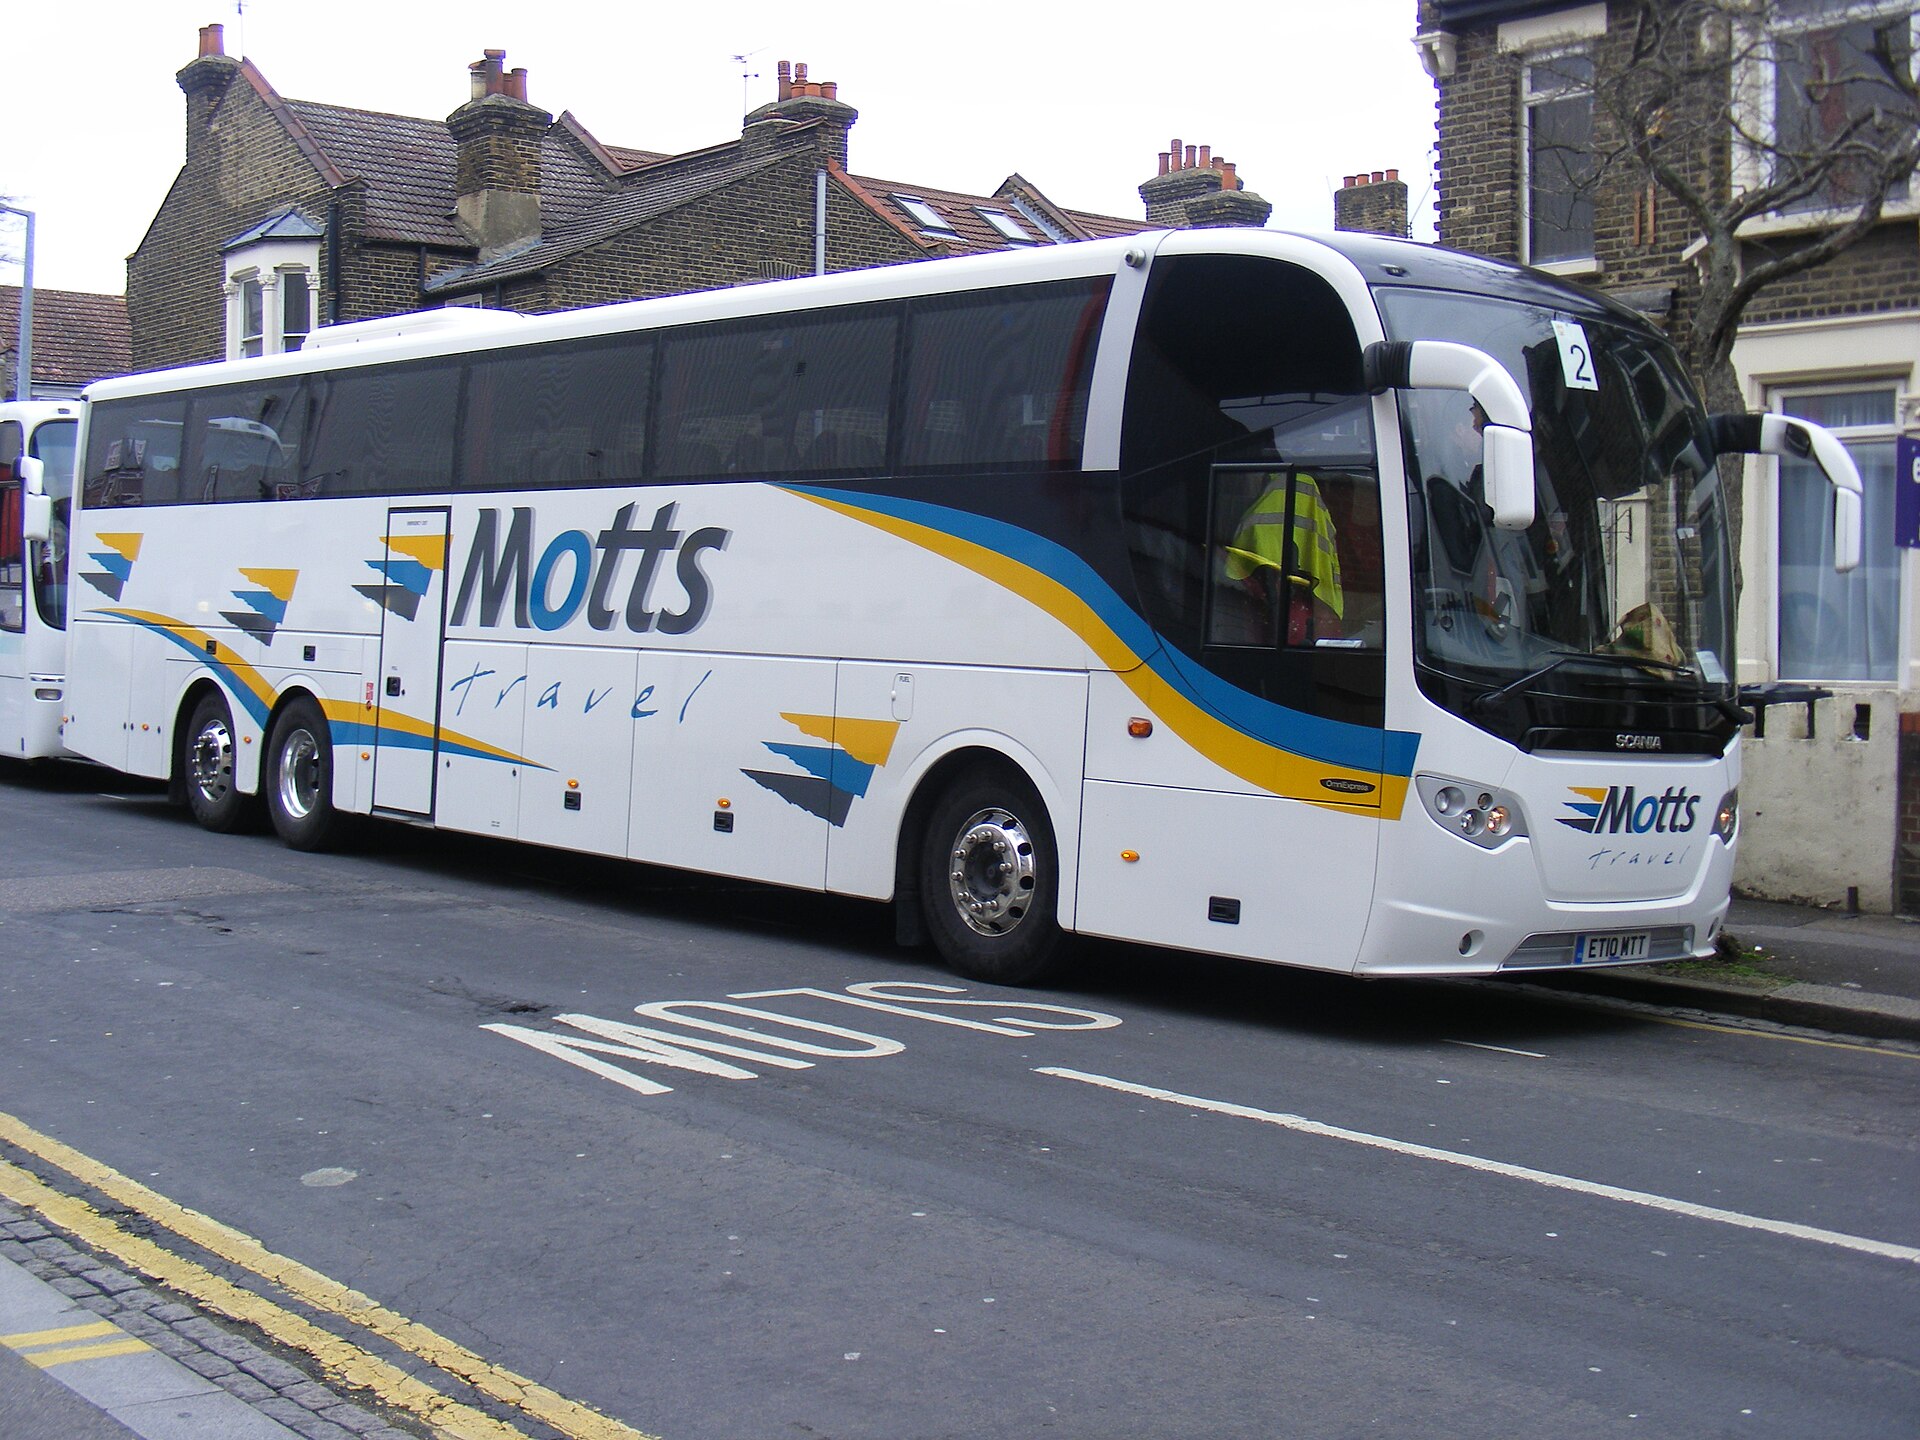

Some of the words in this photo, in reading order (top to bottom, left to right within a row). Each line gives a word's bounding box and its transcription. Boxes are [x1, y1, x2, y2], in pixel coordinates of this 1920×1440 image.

[1570, 344, 1591, 382] 2
[450, 501, 734, 635] Motts
[450, 661, 712, 726] travel
[1615, 734, 1662, 750] SCANIA
[1594, 785, 1701, 834] Motts
[1588, 845, 1691, 870] travel
[1589, 937, 1618, 958] ET10
[1621, 935, 1646, 955] MTT
